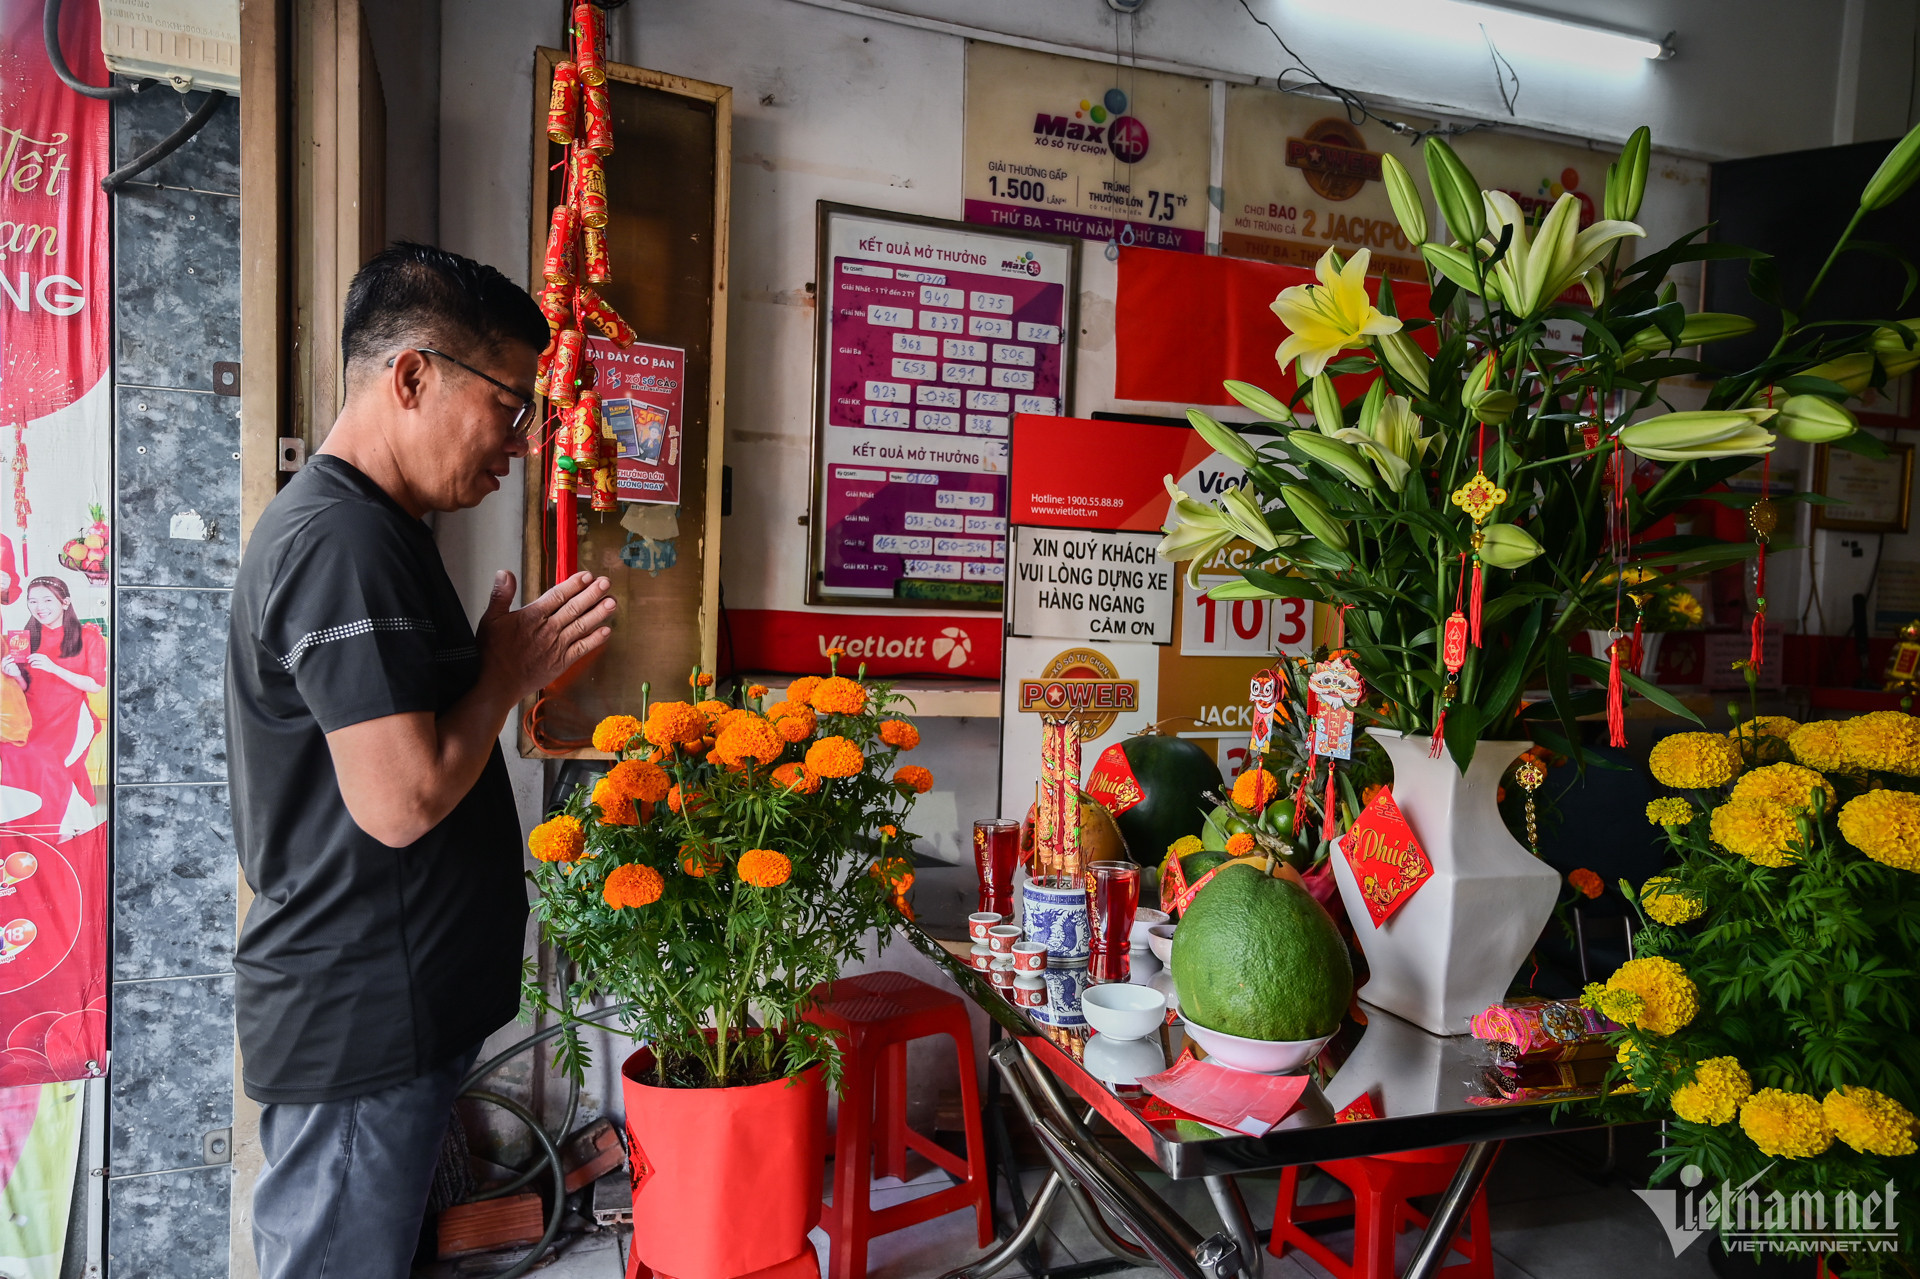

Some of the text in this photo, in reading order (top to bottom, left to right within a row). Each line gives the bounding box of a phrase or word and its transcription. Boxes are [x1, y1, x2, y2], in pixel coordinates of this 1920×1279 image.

[1032, 113, 1106, 144] Max
[1035, 135, 1107, 157] XỔ SỐ TỰ CHỌN
[1289, 142, 1380, 178] POWER
[988, 160, 1068, 182] GIẢI THƯỞNG GẤP
[989, 176, 1044, 203] 1.500
[1102, 180, 1130, 194] TRÚNG
[1089, 191, 1143, 208] THƯỞNG LỚN
[1148, 190, 1175, 222] 7,5
[1244, 203, 1297, 221] CHƠI BAO
[990, 208, 1021, 226] THỨ
[1023, 213, 1042, 228] BA
[1055, 216, 1083, 233] THỨ
[1085, 219, 1115, 238] NĂM
[1157, 228, 1182, 247] BẢY
[1234, 216, 1297, 235] MỚI TRÚNG CẢ
[1302, 209, 1316, 238] 2
[859, 236, 987, 266] KẾT QUẢ MỞ THƯỞNG
[1245, 240, 1269, 256] THỨ
[1273, 244, 1289, 259] BA
[1001, 260, 1026, 271] Max
[1389, 262, 1411, 277] BẢY
[841, 283, 854, 292] Giải
[854, 284, 871, 293] Nhất
[889, 288, 901, 296] đến
[587, 349, 675, 369] TẠI ĐÂY CÓ BÁN
[839, 346, 862, 355] Giải Ba
[642, 375, 656, 386] SỐ
[656, 377, 677, 389] CÀO
[852, 442, 876, 457] KẾT
[879, 446, 904, 460] QUẢ
[908, 446, 927, 461] MỞ
[929, 449, 980, 465] THƯỞNG
[643, 482, 665, 491] NGAY
[649, 471, 665, 481] LỚN
[859, 491, 875, 499] Nhất
[1031, 494, 1124, 508] Hotline: 1900.55.88.89
[1031, 506, 1098, 517] www.vietlott.vn
[1032, 538, 1156, 565] XIN QUÝ KHÁCH
[1019, 562, 1168, 592] VUI LÒNG DỰNG XE
[1039, 587, 1145, 614] HÀNG NGANG
[1090, 616, 1155, 636] CẢM ƠN
[818, 635, 927, 658] Vietlott
[1052, 652, 1110, 675] XỔ SỐ TỰ CHỌN
[1023, 683, 1135, 708] POWER
[1090, 771, 1125, 795] Phúc
[1360, 828, 1408, 868] Phúc
[6, 926, 25, 942] 18
